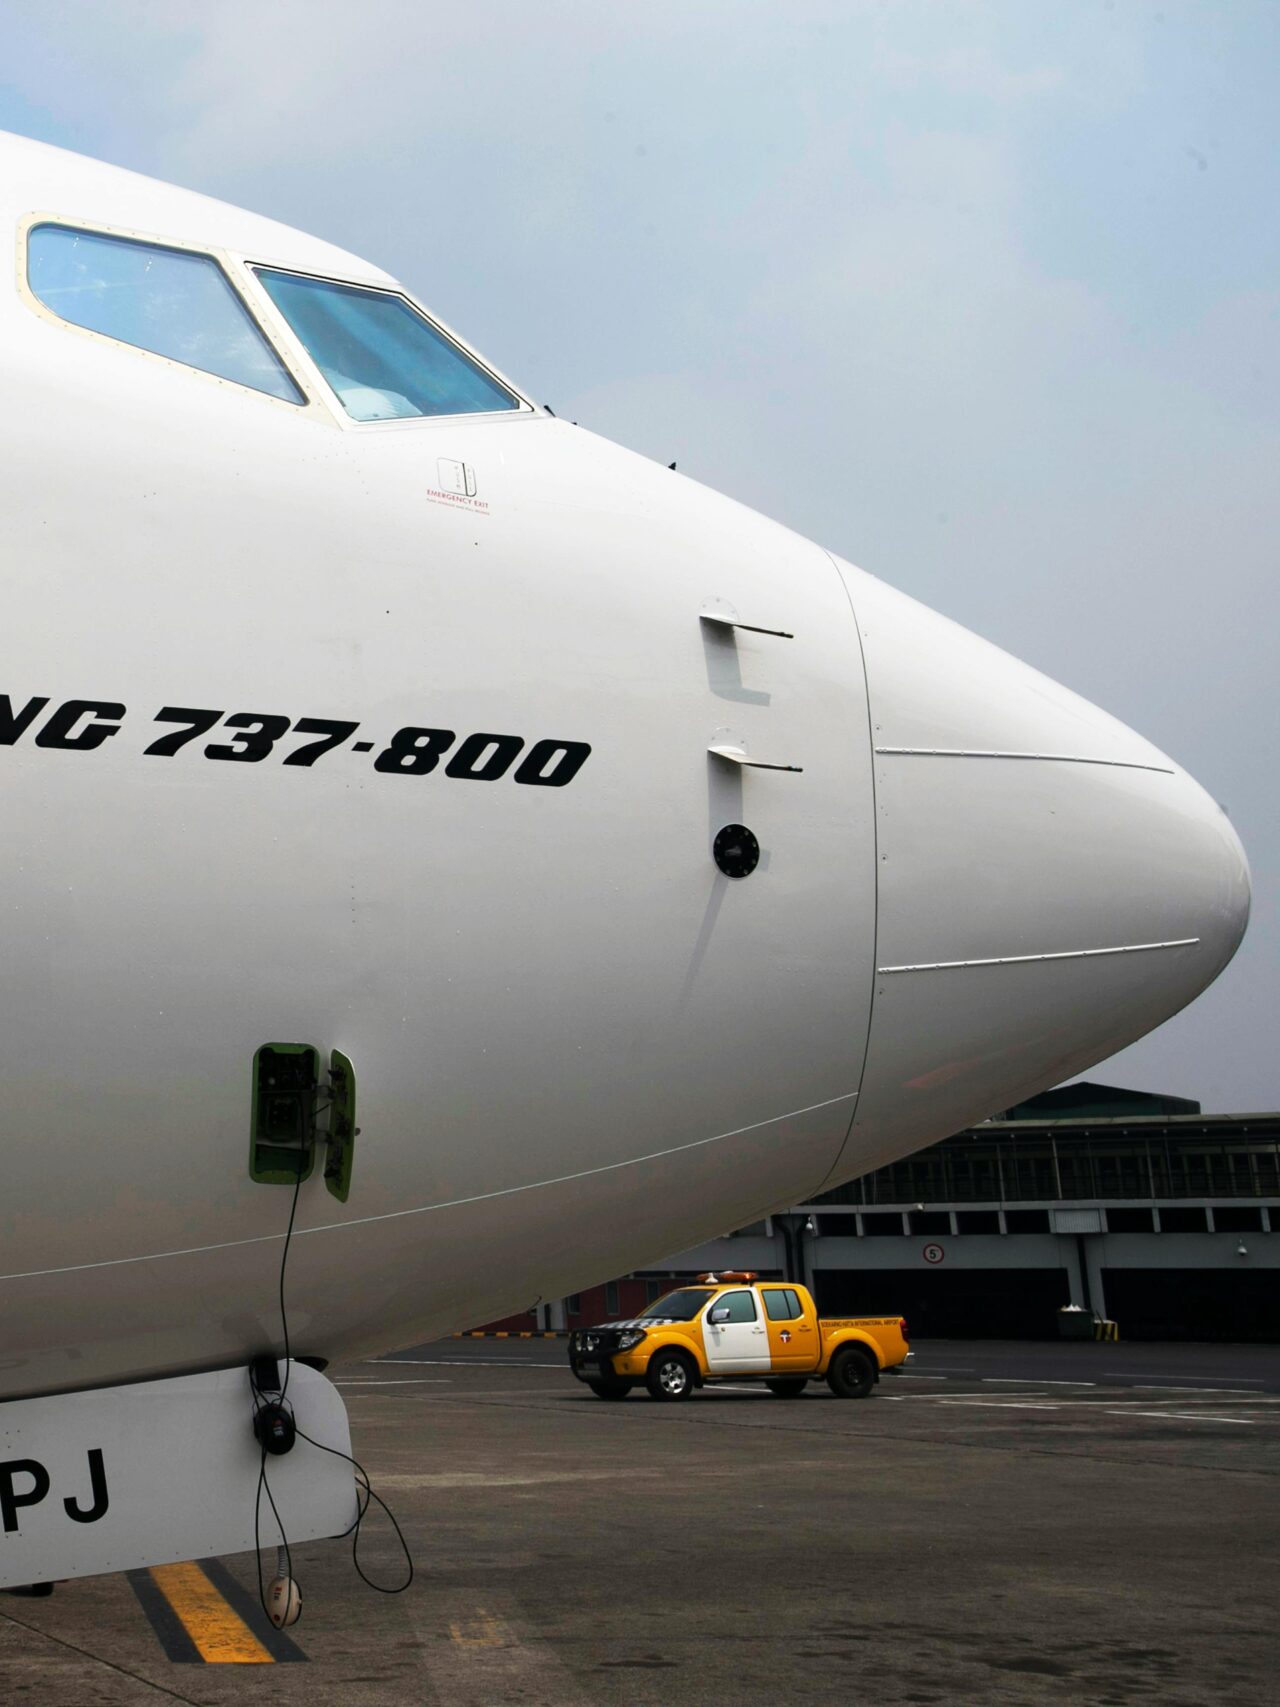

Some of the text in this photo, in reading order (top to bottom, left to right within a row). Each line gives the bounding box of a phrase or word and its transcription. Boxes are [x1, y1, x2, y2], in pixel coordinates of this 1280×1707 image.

[426, 489, 472, 505] EMERGENCY
[474, 500, 489, 509] EXIT
[141, 705, 593, 788] 737-800
